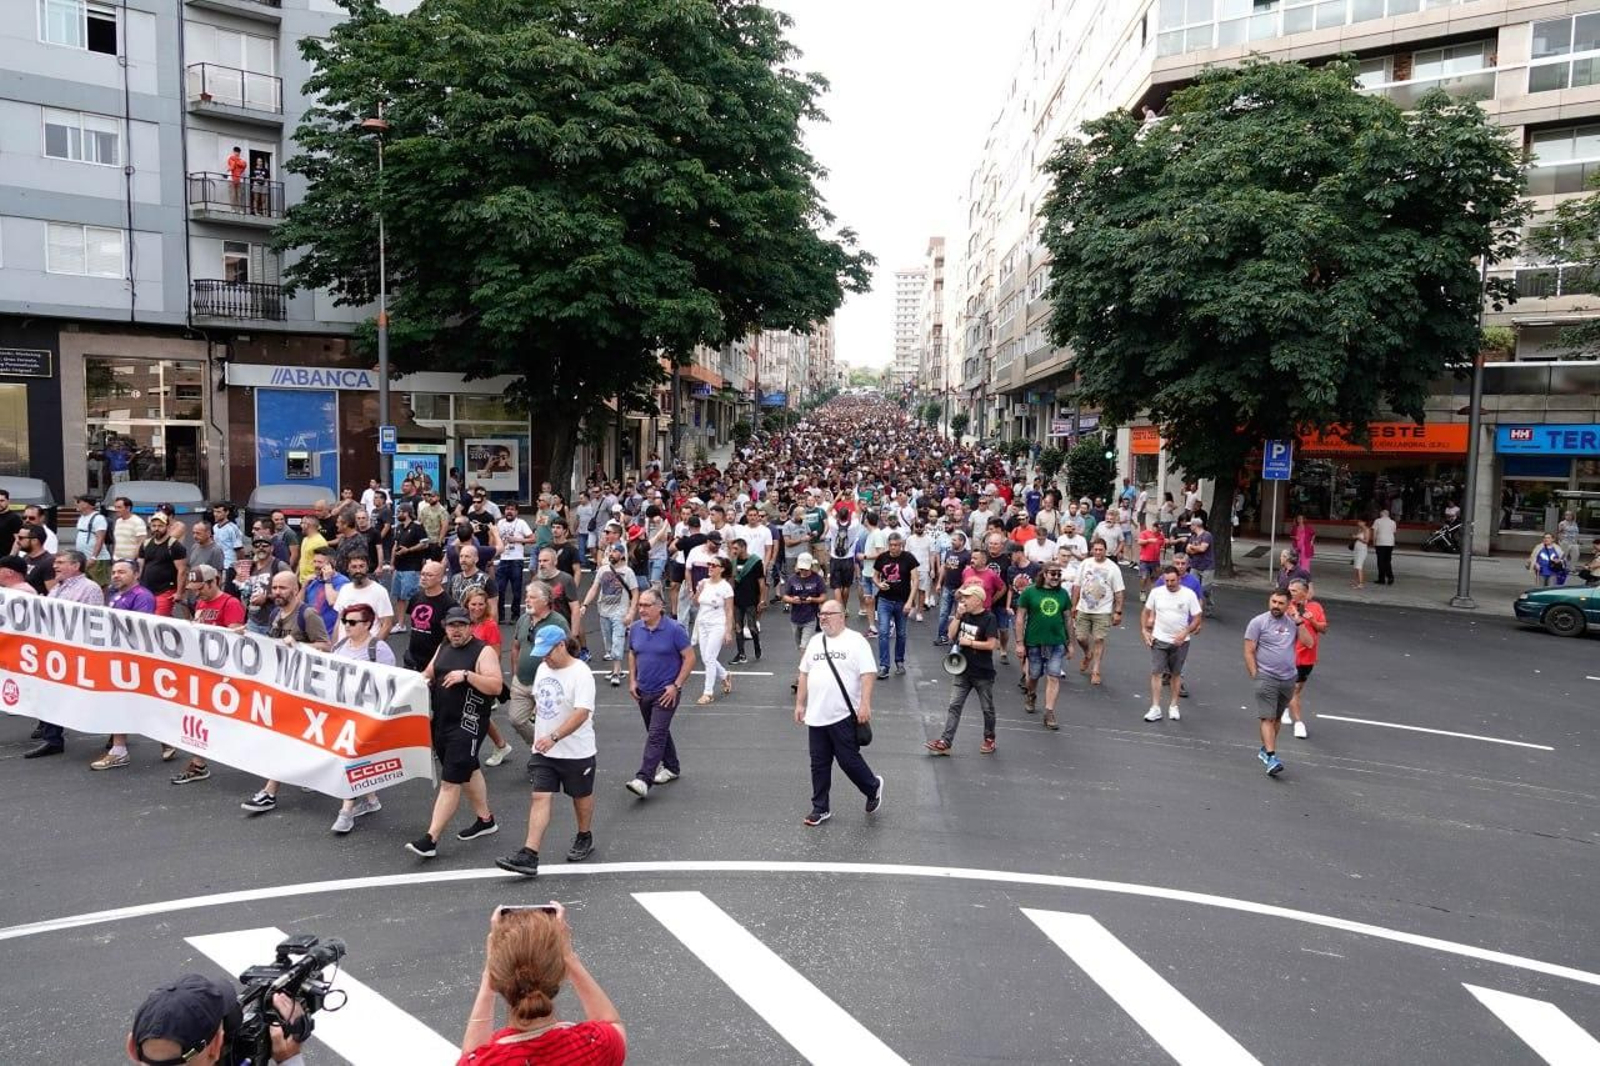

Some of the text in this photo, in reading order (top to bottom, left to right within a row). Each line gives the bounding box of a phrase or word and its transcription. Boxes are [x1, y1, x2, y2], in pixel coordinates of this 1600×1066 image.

[280, 368, 373, 388] ABANCA
[1545, 430, 1600, 450] TER
[1272, 443, 1286, 459] P
[0, 593, 412, 717] ONVENIO DO METAL
[19, 643, 359, 756] SOLUCIÓN XA
[350, 760, 399, 780] CCOO
[350, 770, 404, 792] industria
